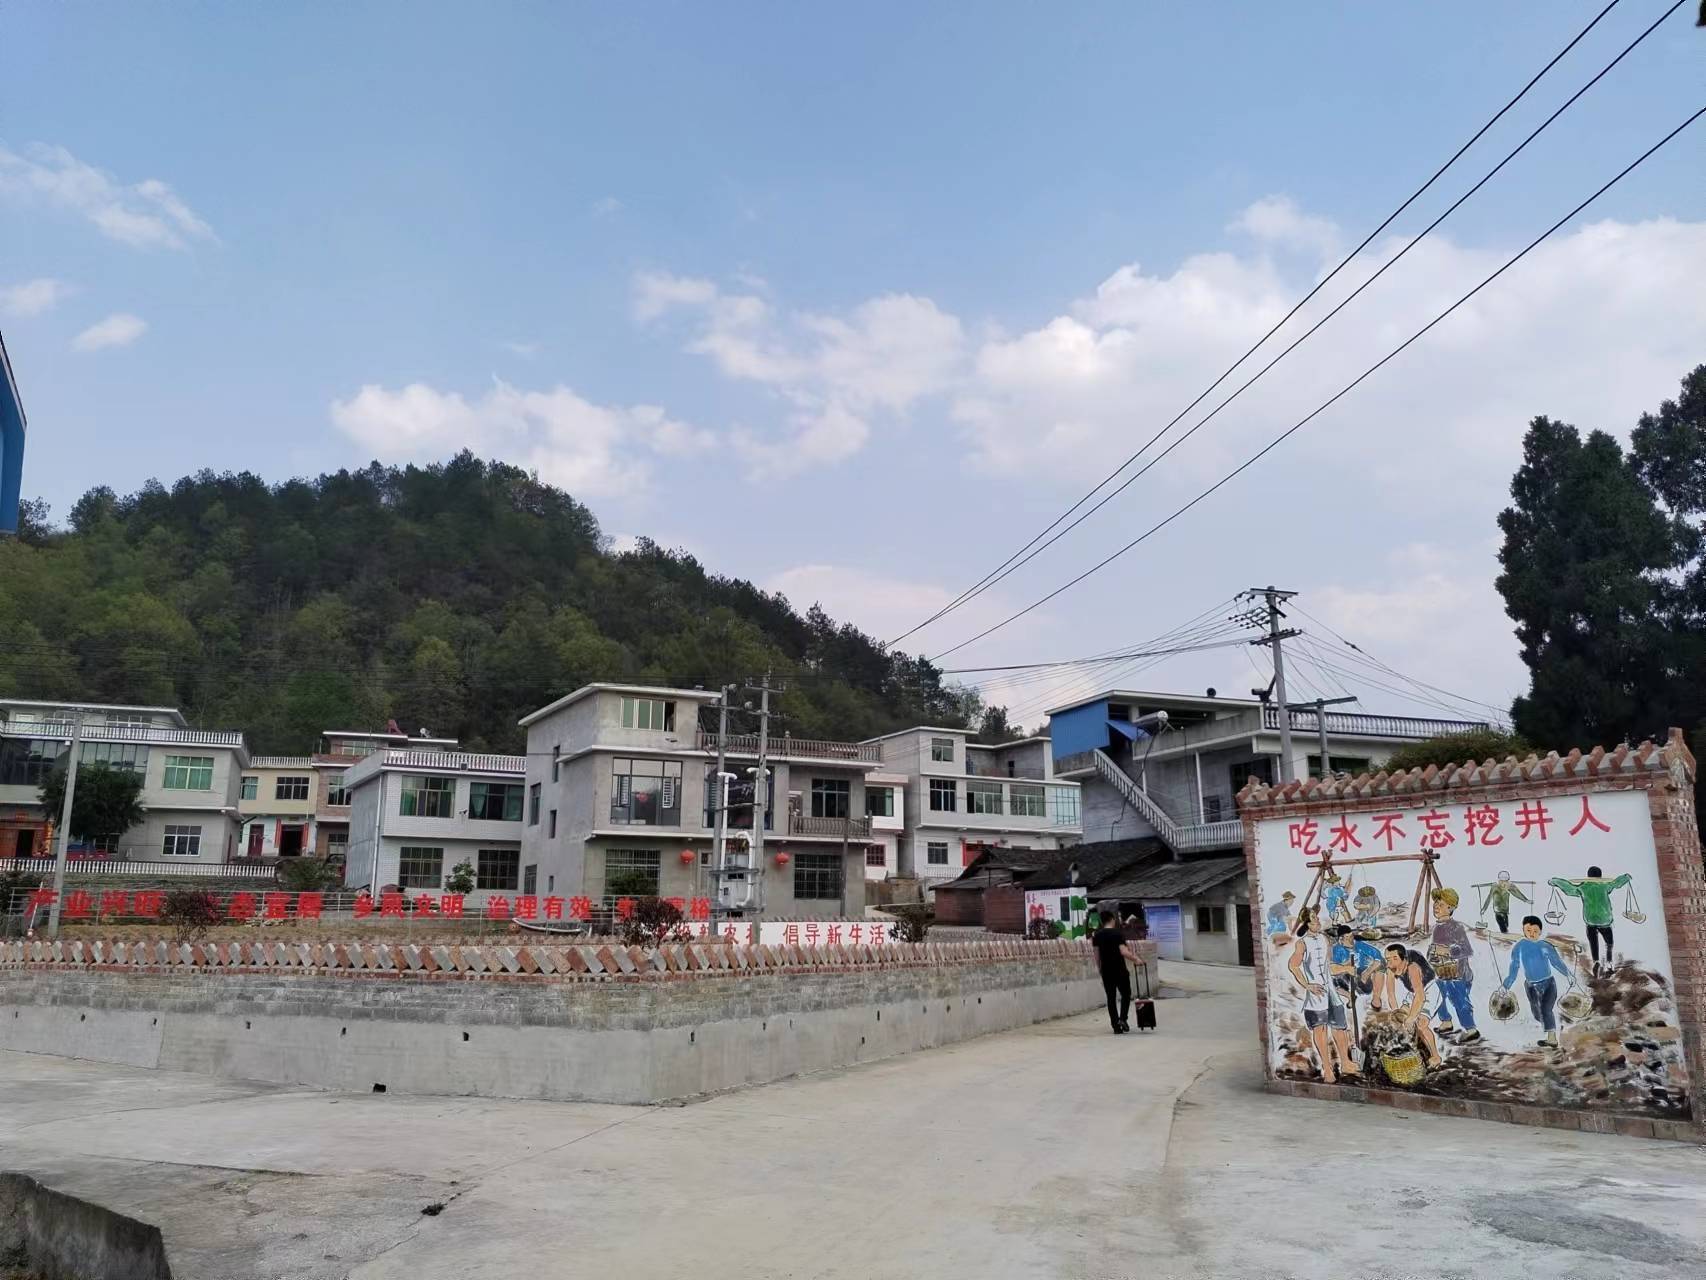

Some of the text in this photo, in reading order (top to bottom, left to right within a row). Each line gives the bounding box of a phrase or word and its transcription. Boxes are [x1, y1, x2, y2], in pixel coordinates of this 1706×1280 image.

[1289, 795, 1611, 855] 吃水不忘挖井人
[353, 890, 464, 919] 乡风文明
[488, 895, 592, 921] 治理有效
[782, 923, 885, 945] 倡导新生活
